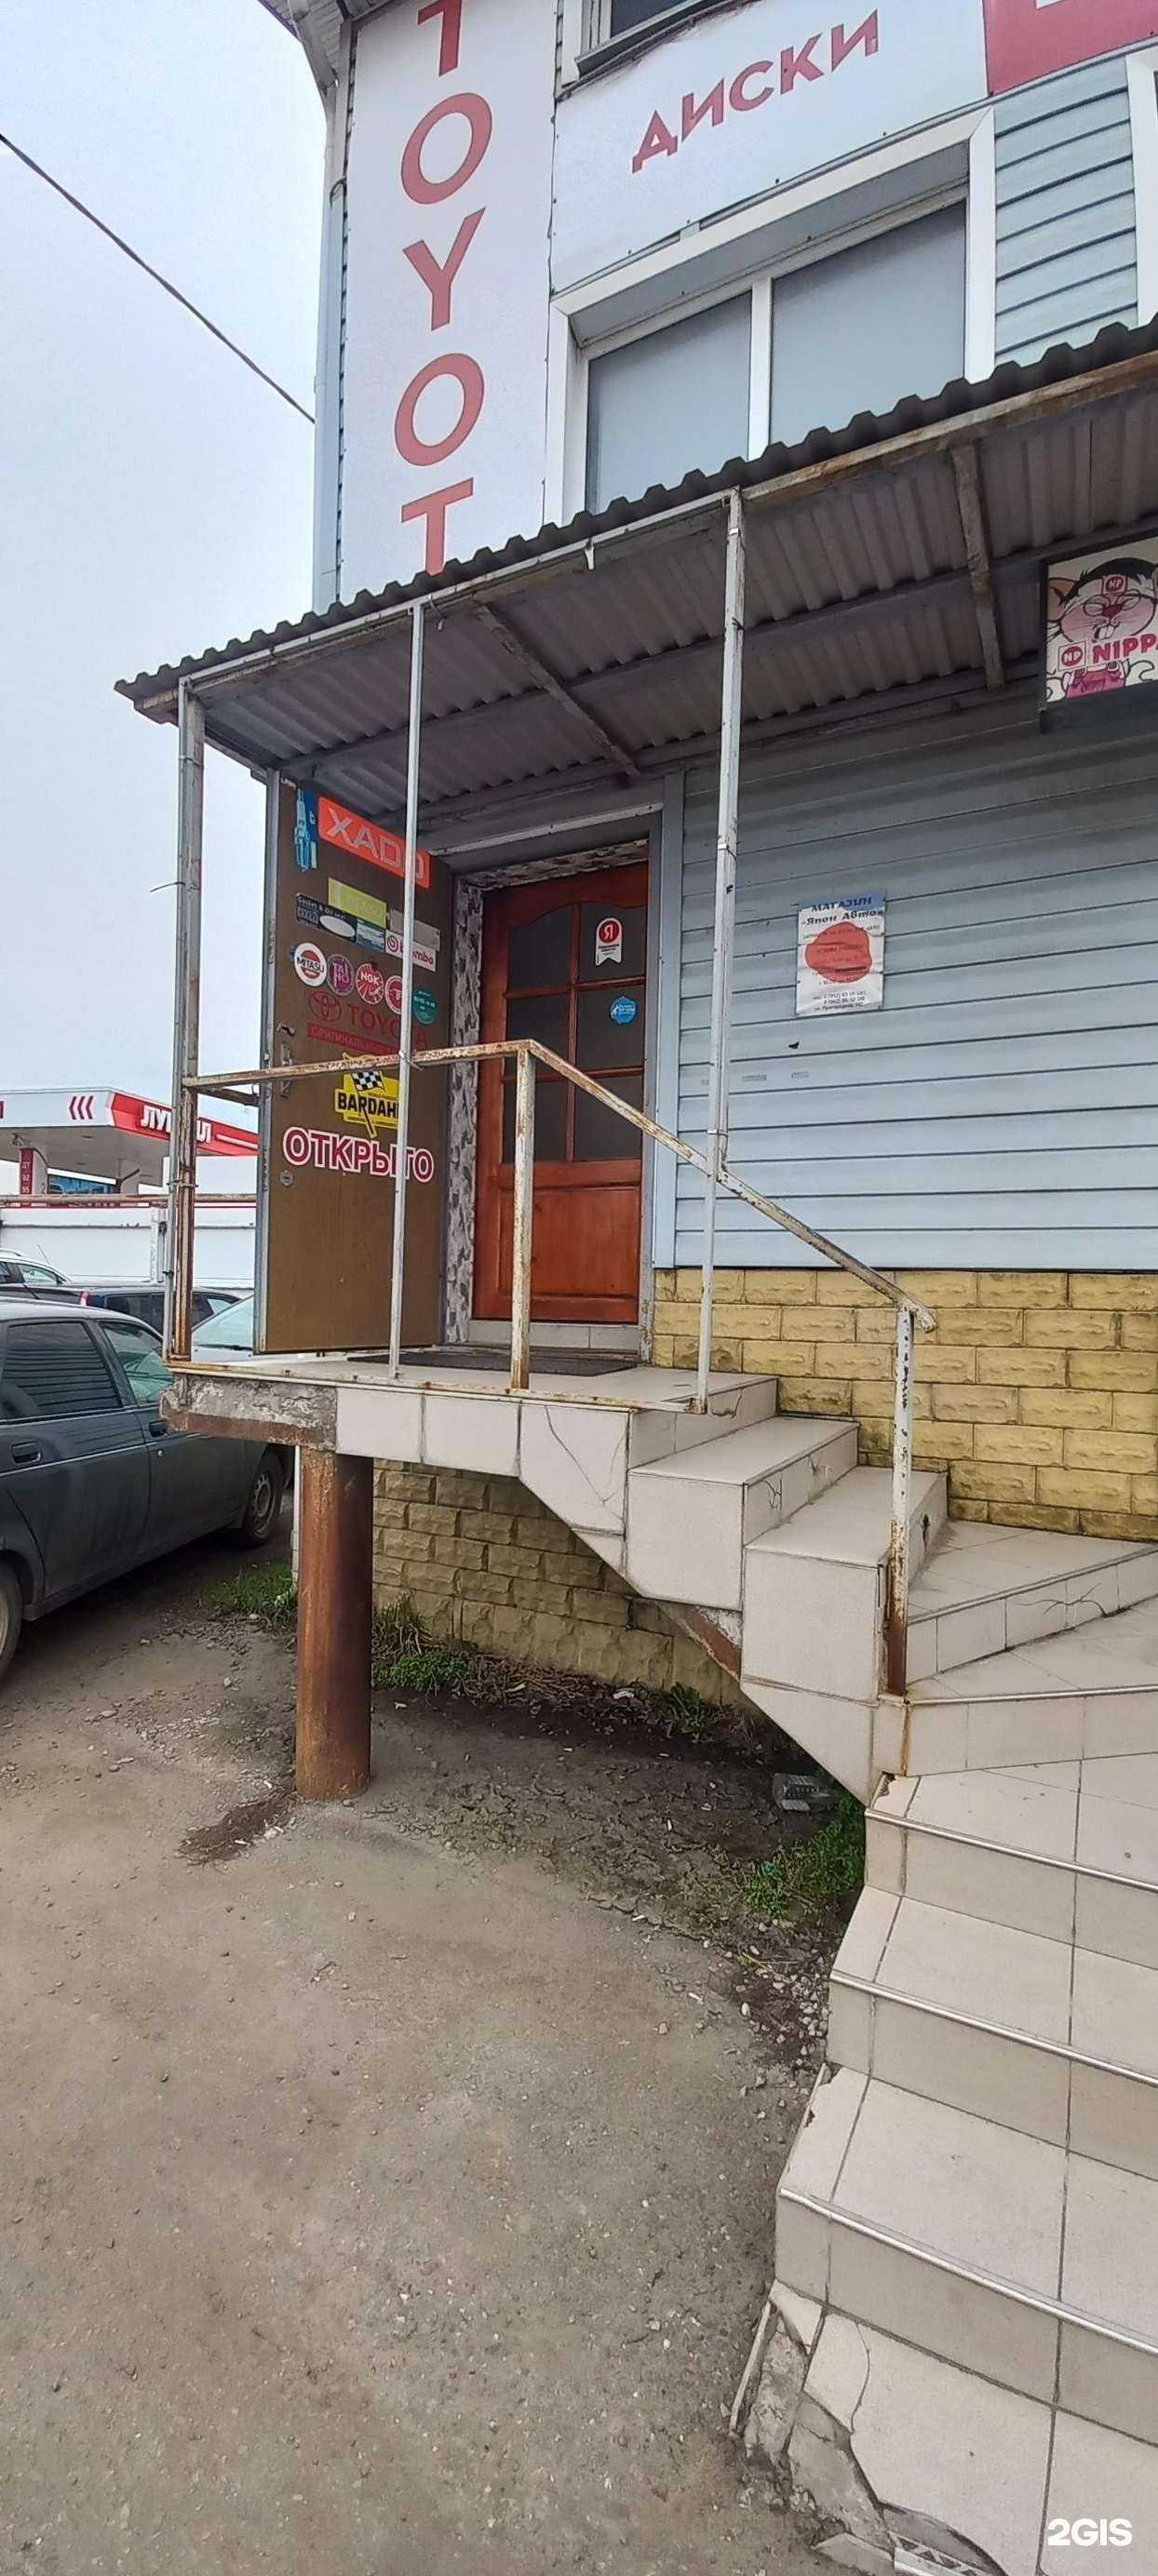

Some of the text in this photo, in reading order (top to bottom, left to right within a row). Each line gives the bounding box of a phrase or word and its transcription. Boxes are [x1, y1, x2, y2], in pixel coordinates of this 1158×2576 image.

[632, 9, 880, 174] ДИСКИ
[1093, 634, 1158, 664] NIPP
[360, 972, 380, 986] NGK
[347, 1004, 428, 1049] TOYOA
[338, 1093, 399, 1119] BARDAH
[141, 1105, 212, 1144] ЛУЛ
